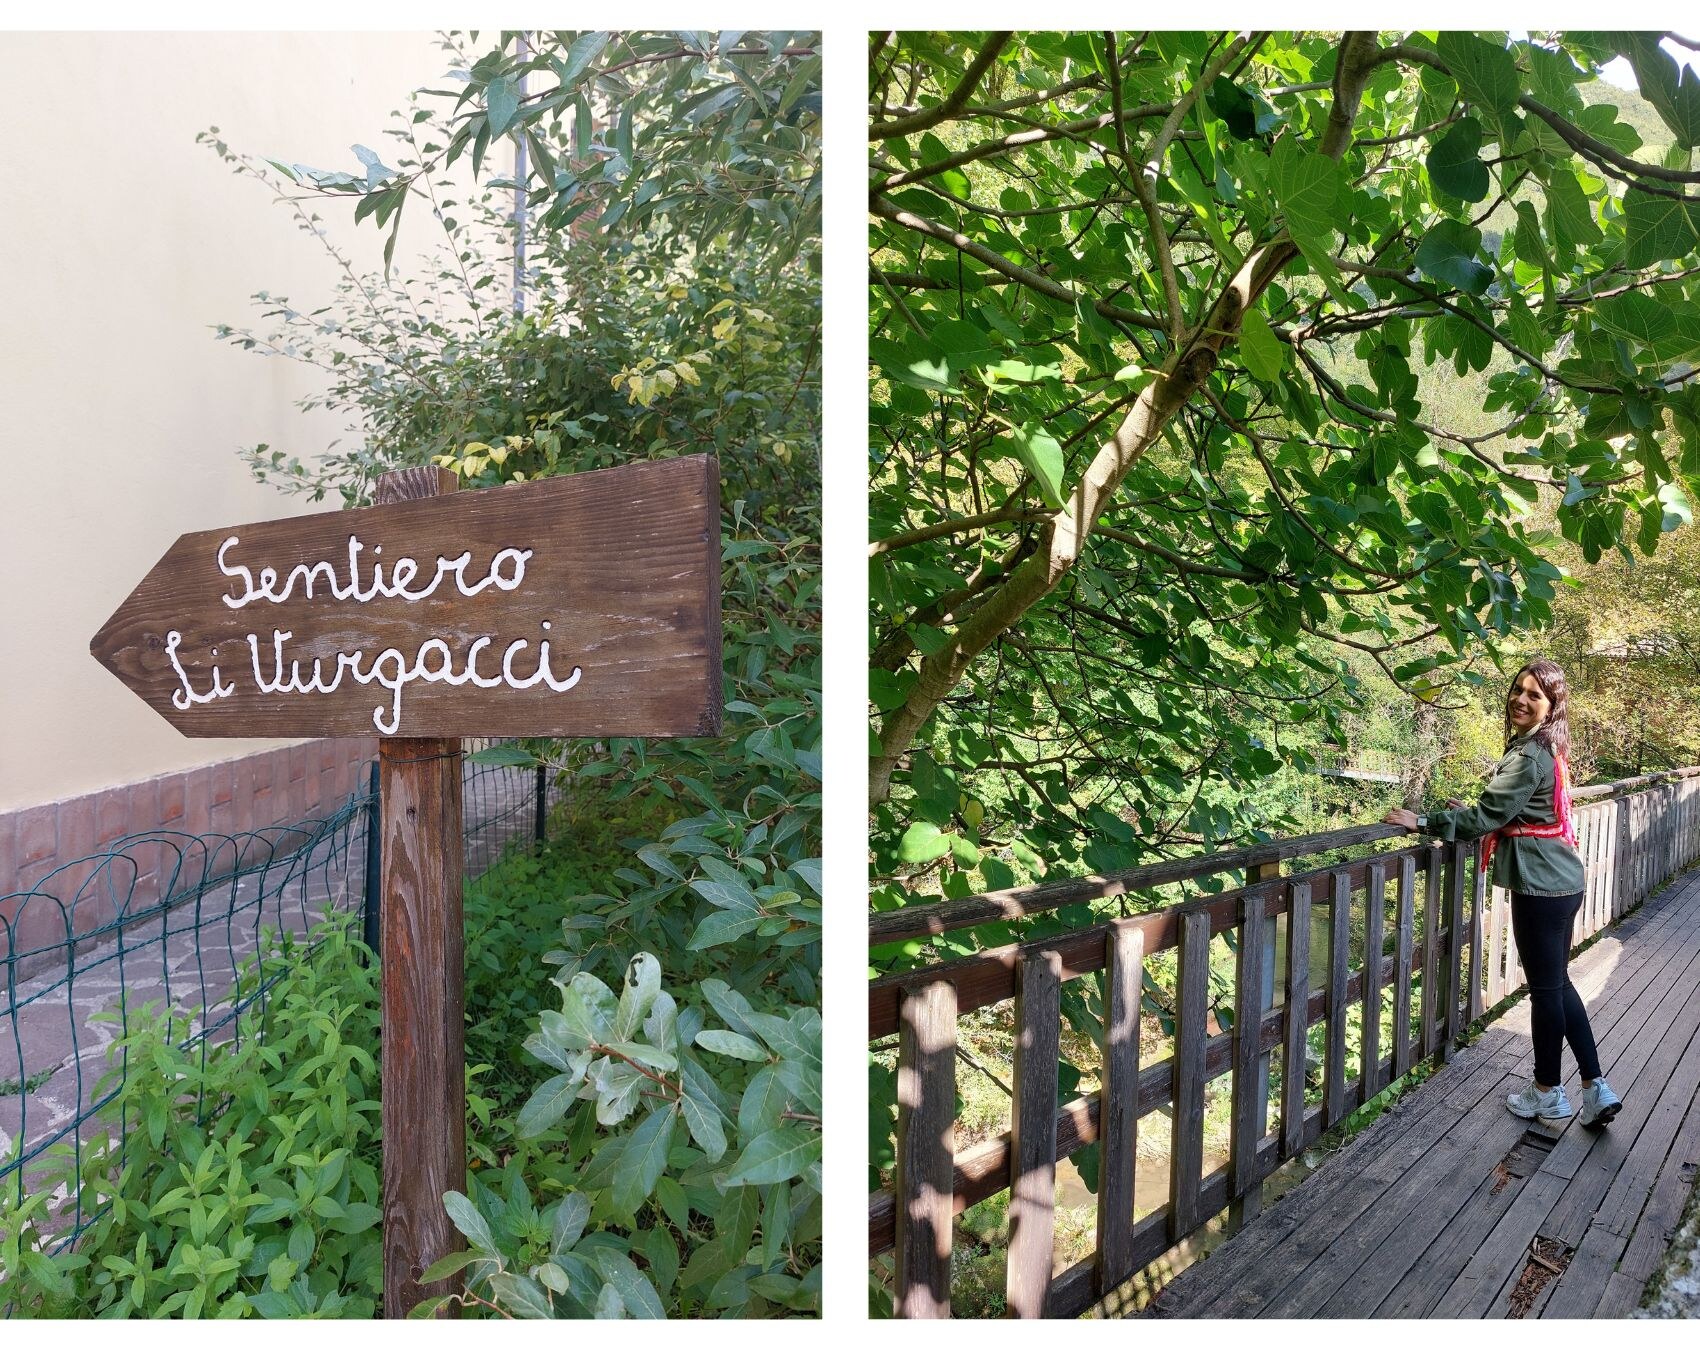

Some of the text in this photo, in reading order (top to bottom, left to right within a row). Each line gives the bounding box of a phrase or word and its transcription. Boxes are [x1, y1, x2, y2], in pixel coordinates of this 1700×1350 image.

[217, 535, 533, 609] Sentiero
[164, 620, 582, 736] Li Vurgacci
